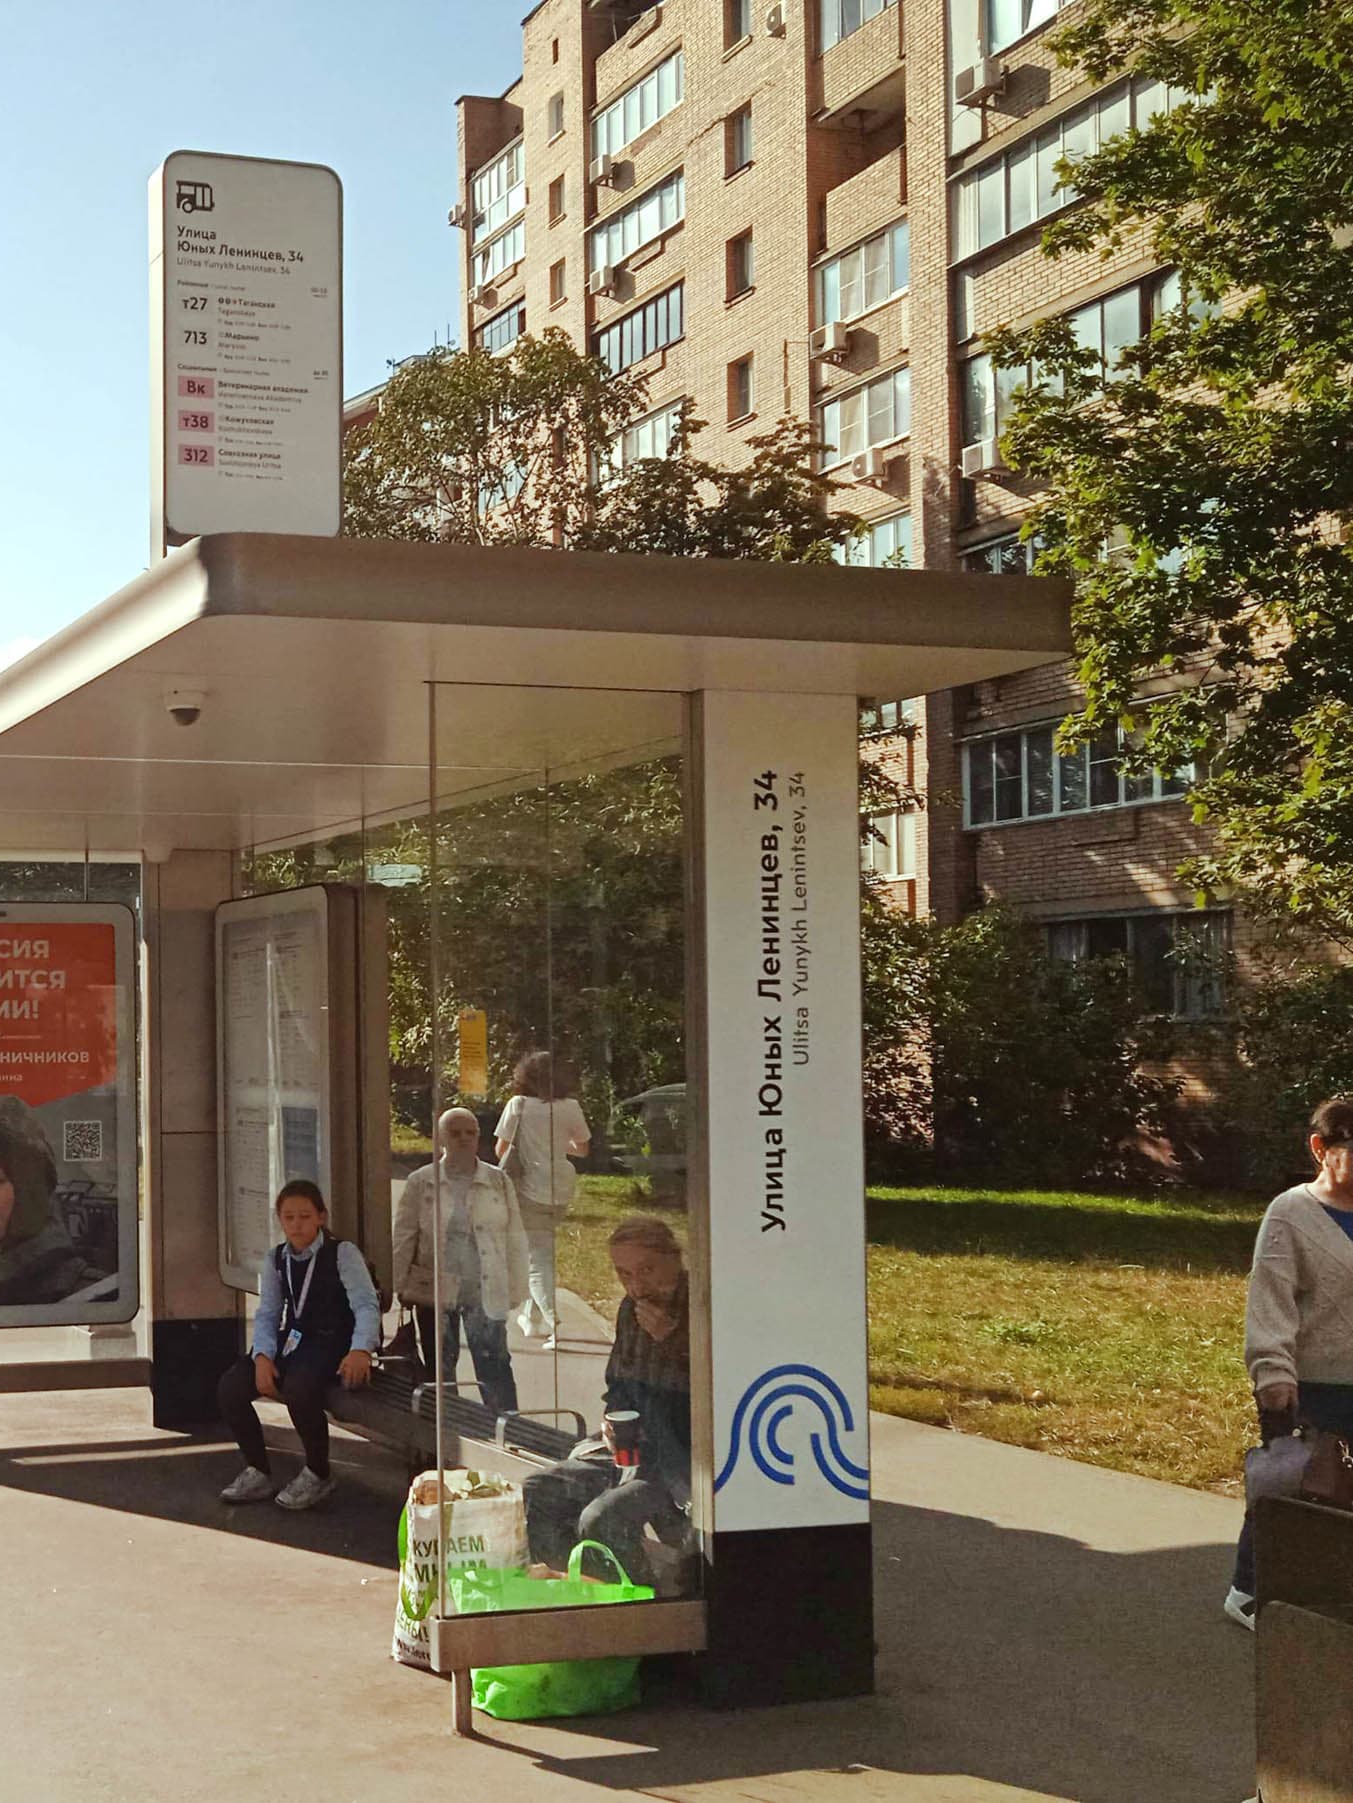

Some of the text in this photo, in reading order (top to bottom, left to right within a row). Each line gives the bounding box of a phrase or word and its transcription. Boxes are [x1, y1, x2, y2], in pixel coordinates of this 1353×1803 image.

[176, 224, 217, 241] Улица
[177, 240, 304, 263] Юных Ленинцев, 34
[184, 330, 208, 345] 713
[186, 380, 206, 395] Вк
[184, 448, 209, 464] 312
[789, 770, 814, 1067] Ulitsa Yunykh Lenintsev, 34
[753, 768, 786, 1233] Улица Юных Ленинцев, 34
